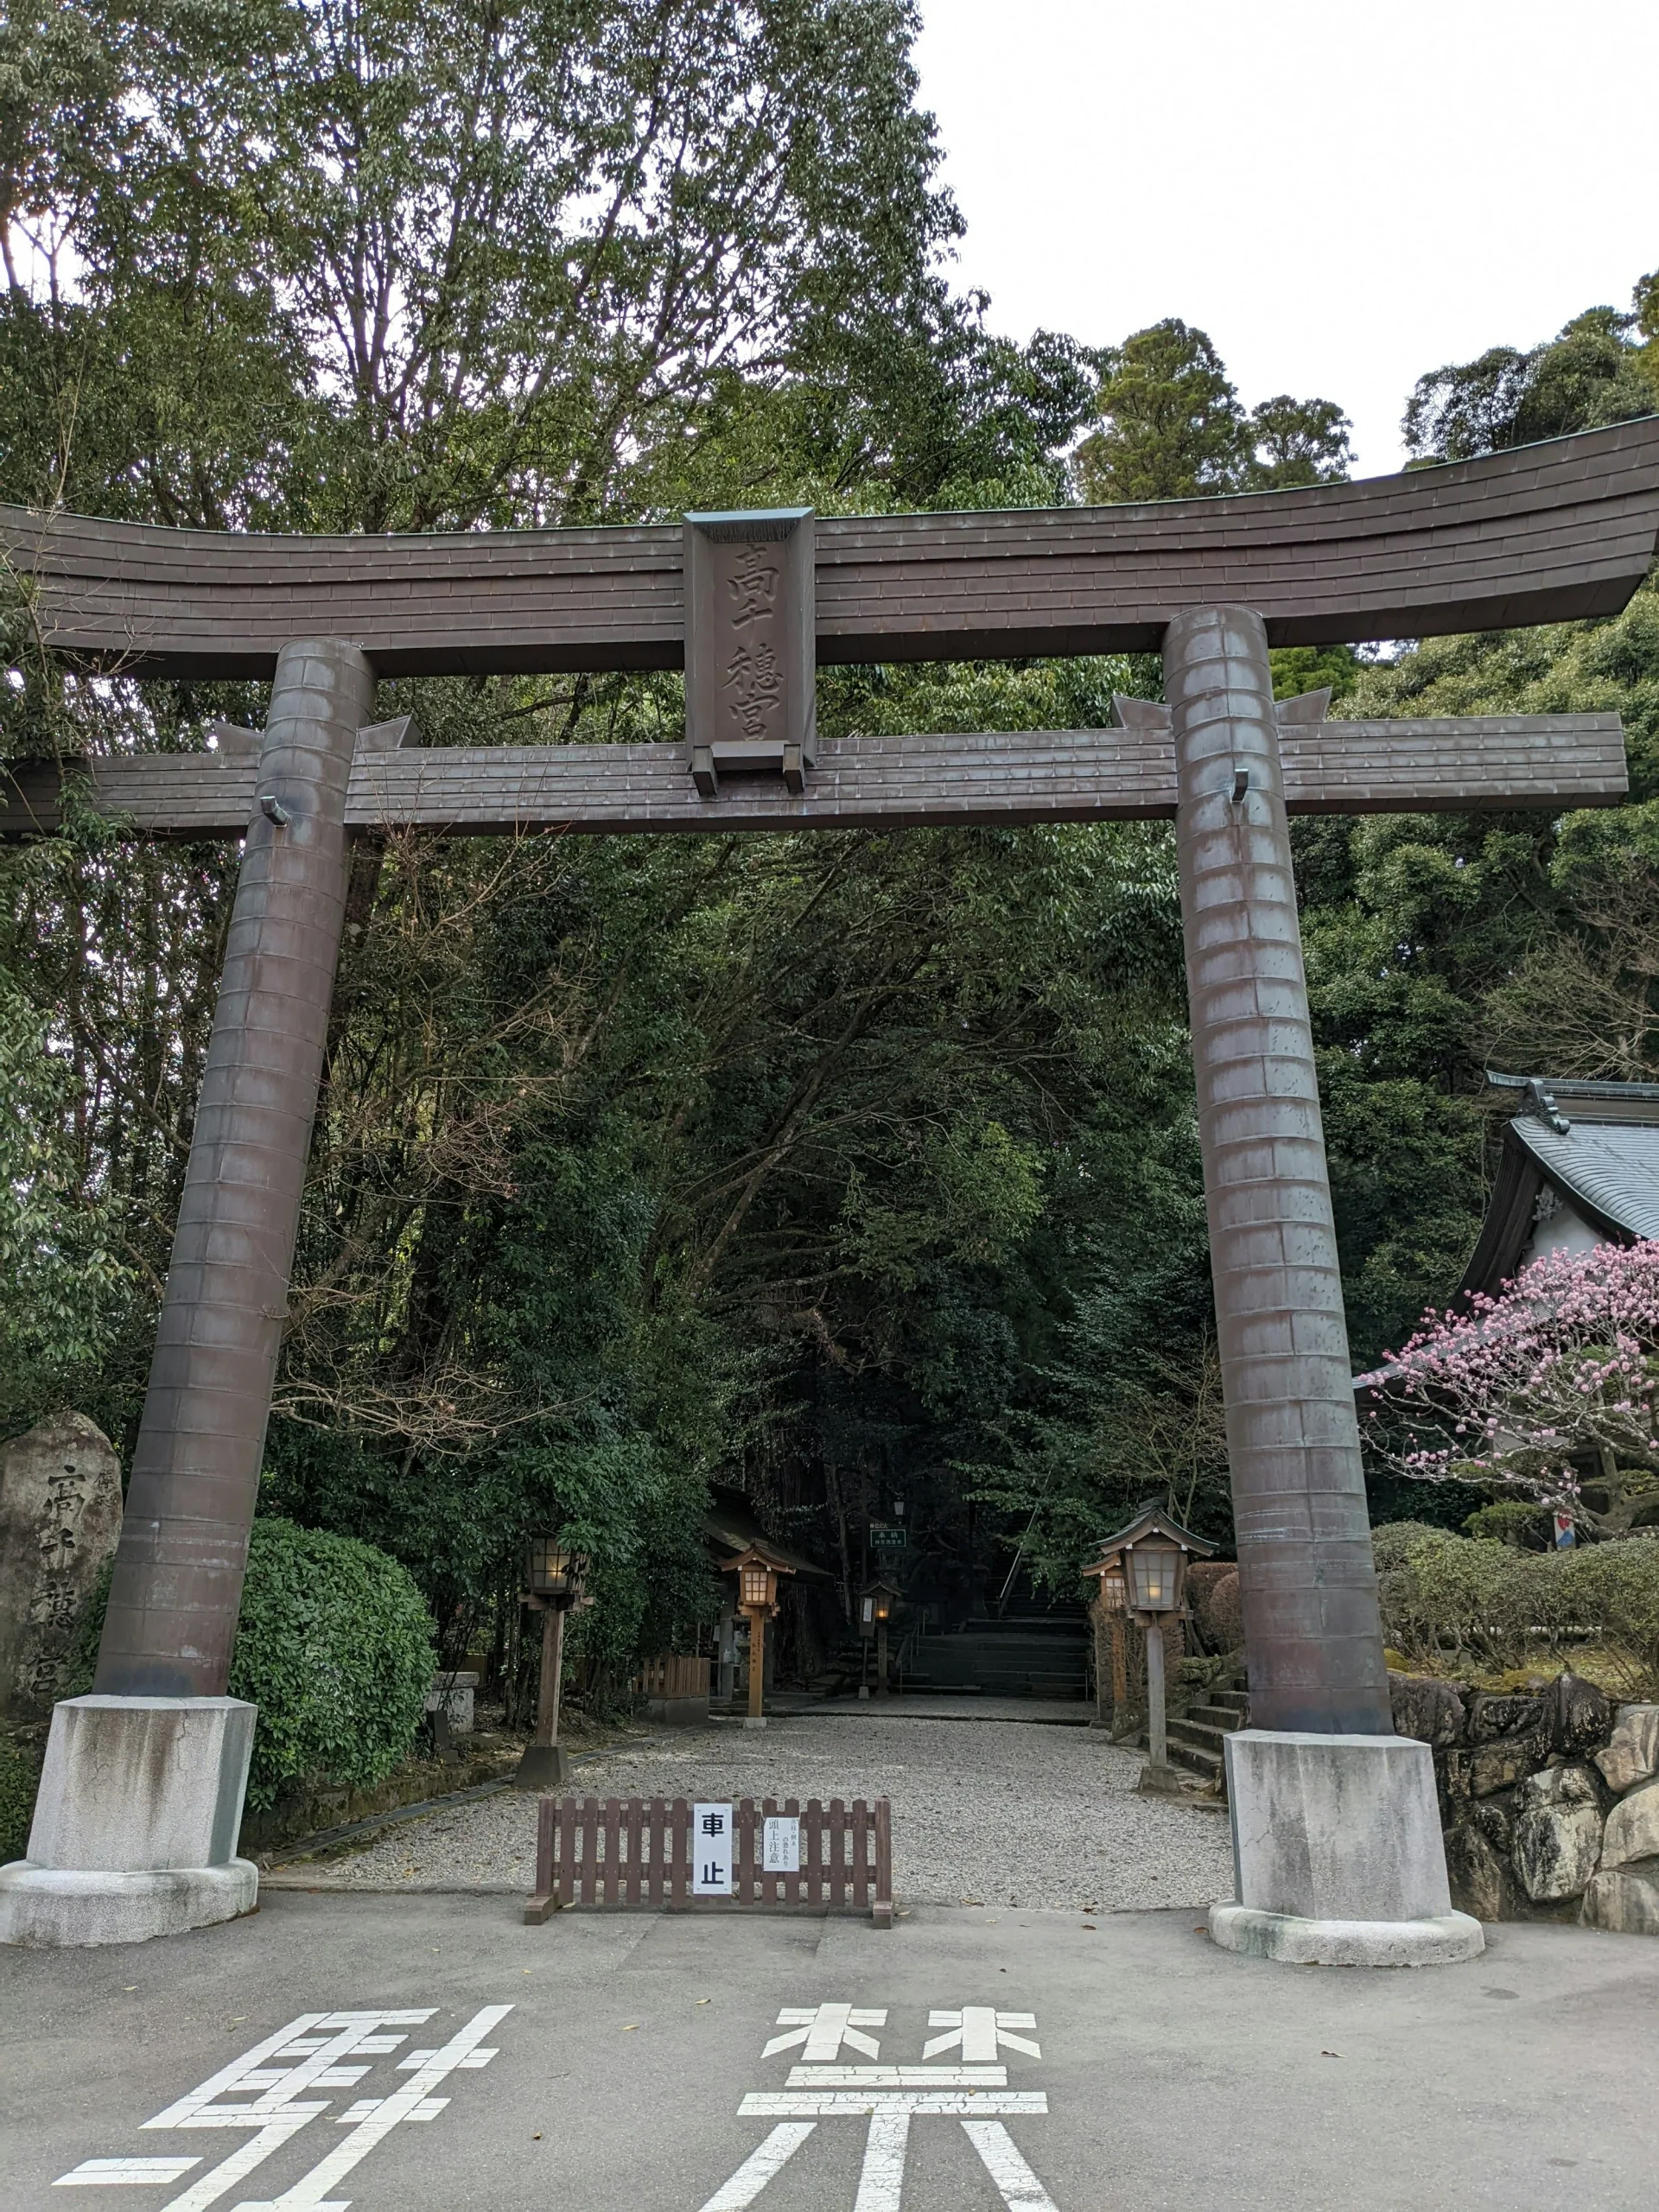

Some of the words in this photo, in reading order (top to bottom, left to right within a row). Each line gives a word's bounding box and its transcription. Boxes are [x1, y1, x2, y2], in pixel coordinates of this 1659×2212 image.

[701, 1812, 724, 1885] 車止
[769, 1819, 779, 1864] 頭上注意
